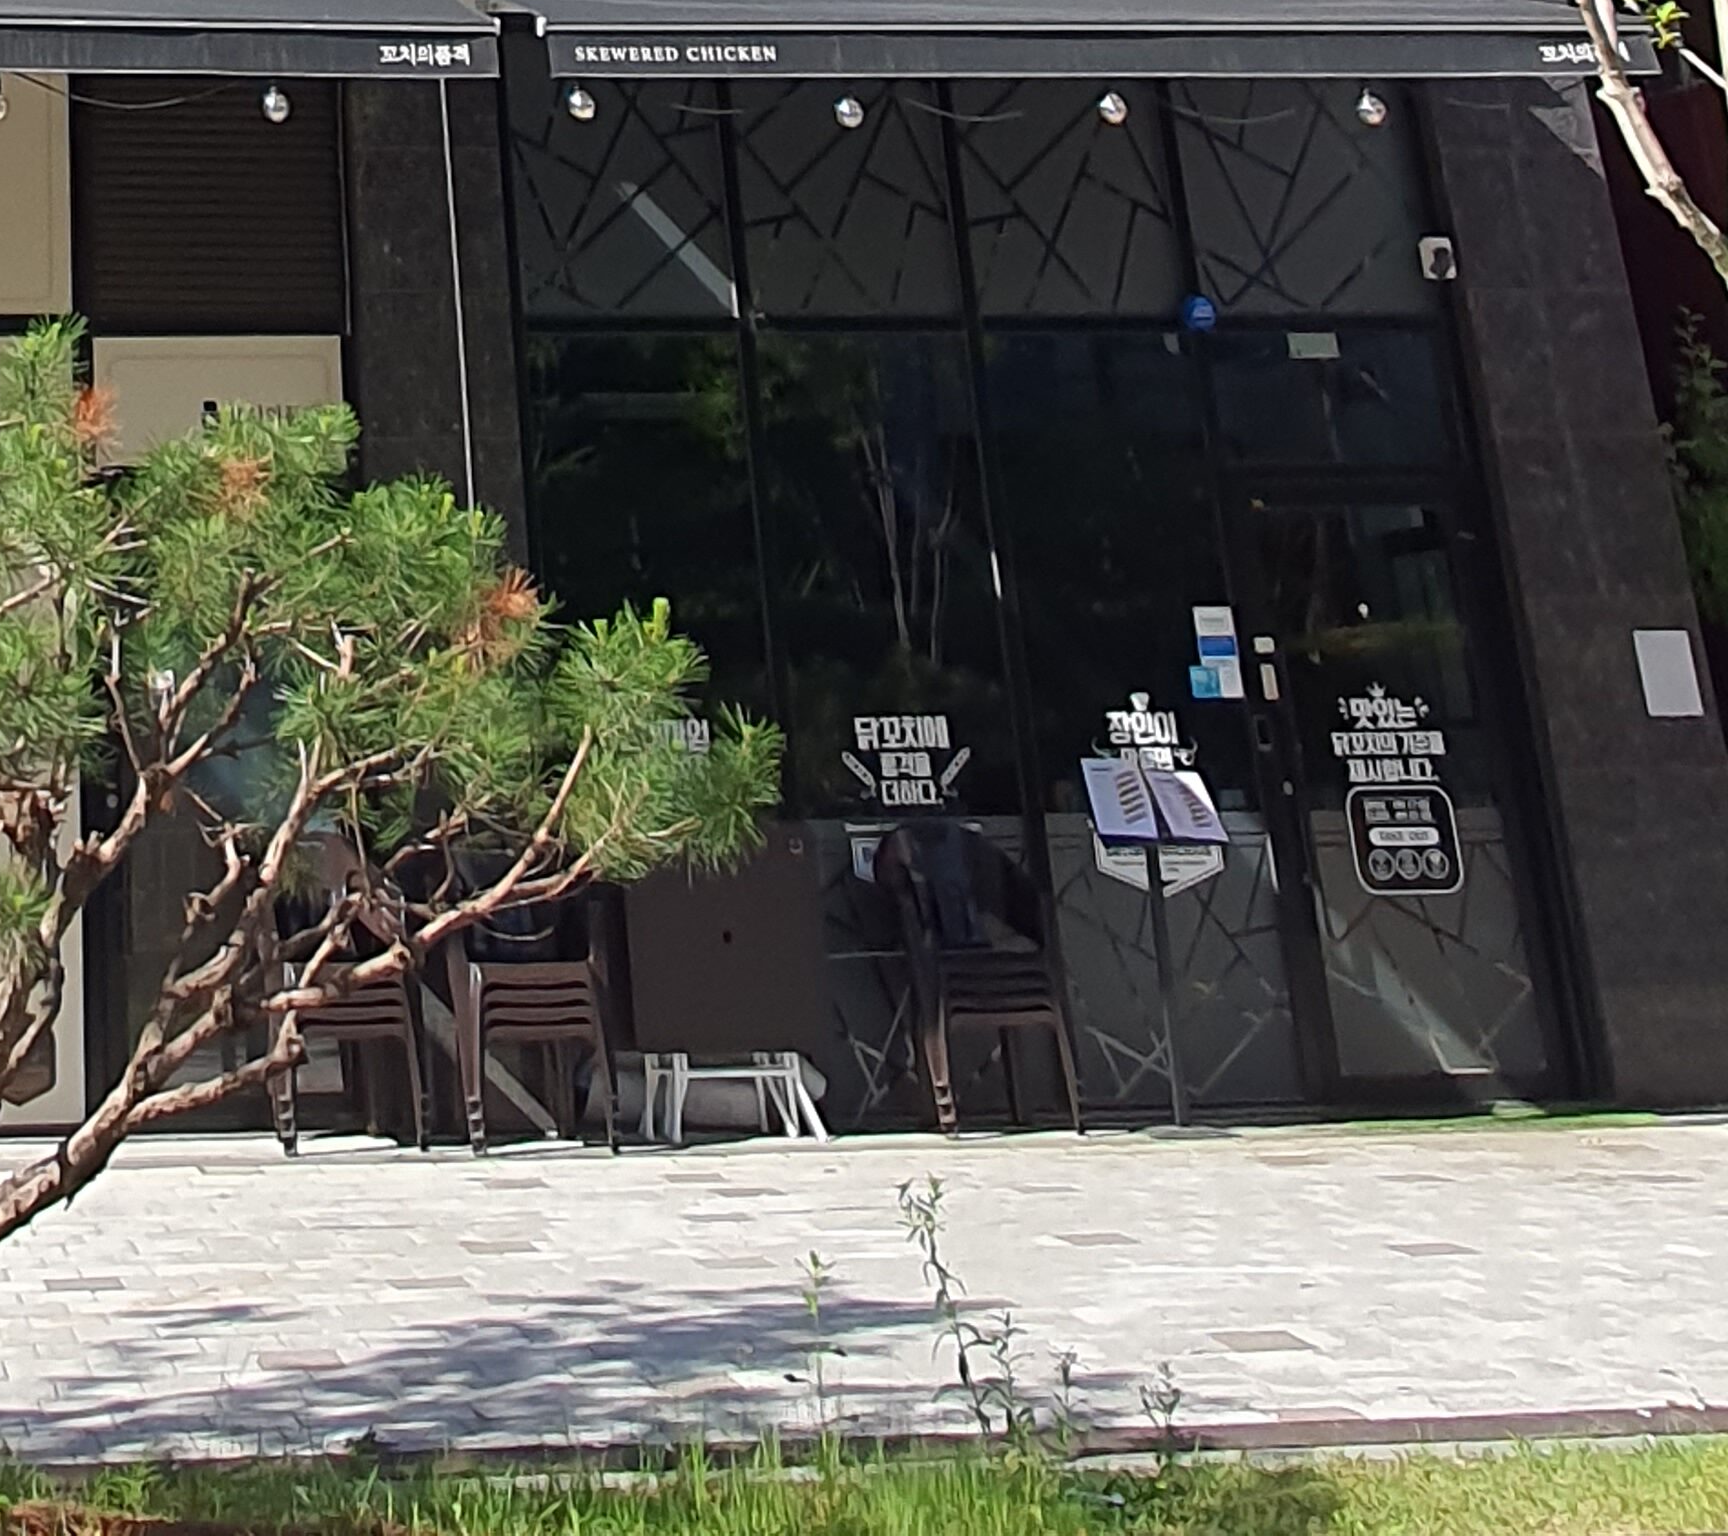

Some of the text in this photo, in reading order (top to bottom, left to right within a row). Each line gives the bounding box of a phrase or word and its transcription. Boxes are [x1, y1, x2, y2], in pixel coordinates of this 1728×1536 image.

[379, 43, 471, 66] 꼬치의품격
[575, 46, 777, 64] SKEWERED CHICKEN
[1538, 41, 1630, 63] 꼬치의
[1348, 696, 1419, 729] 맛있는
[853, 715, 951, 750] 닭꼬치에
[1105, 710, 1179, 745] 장인이
[880, 779, 944, 806] 더하다.
